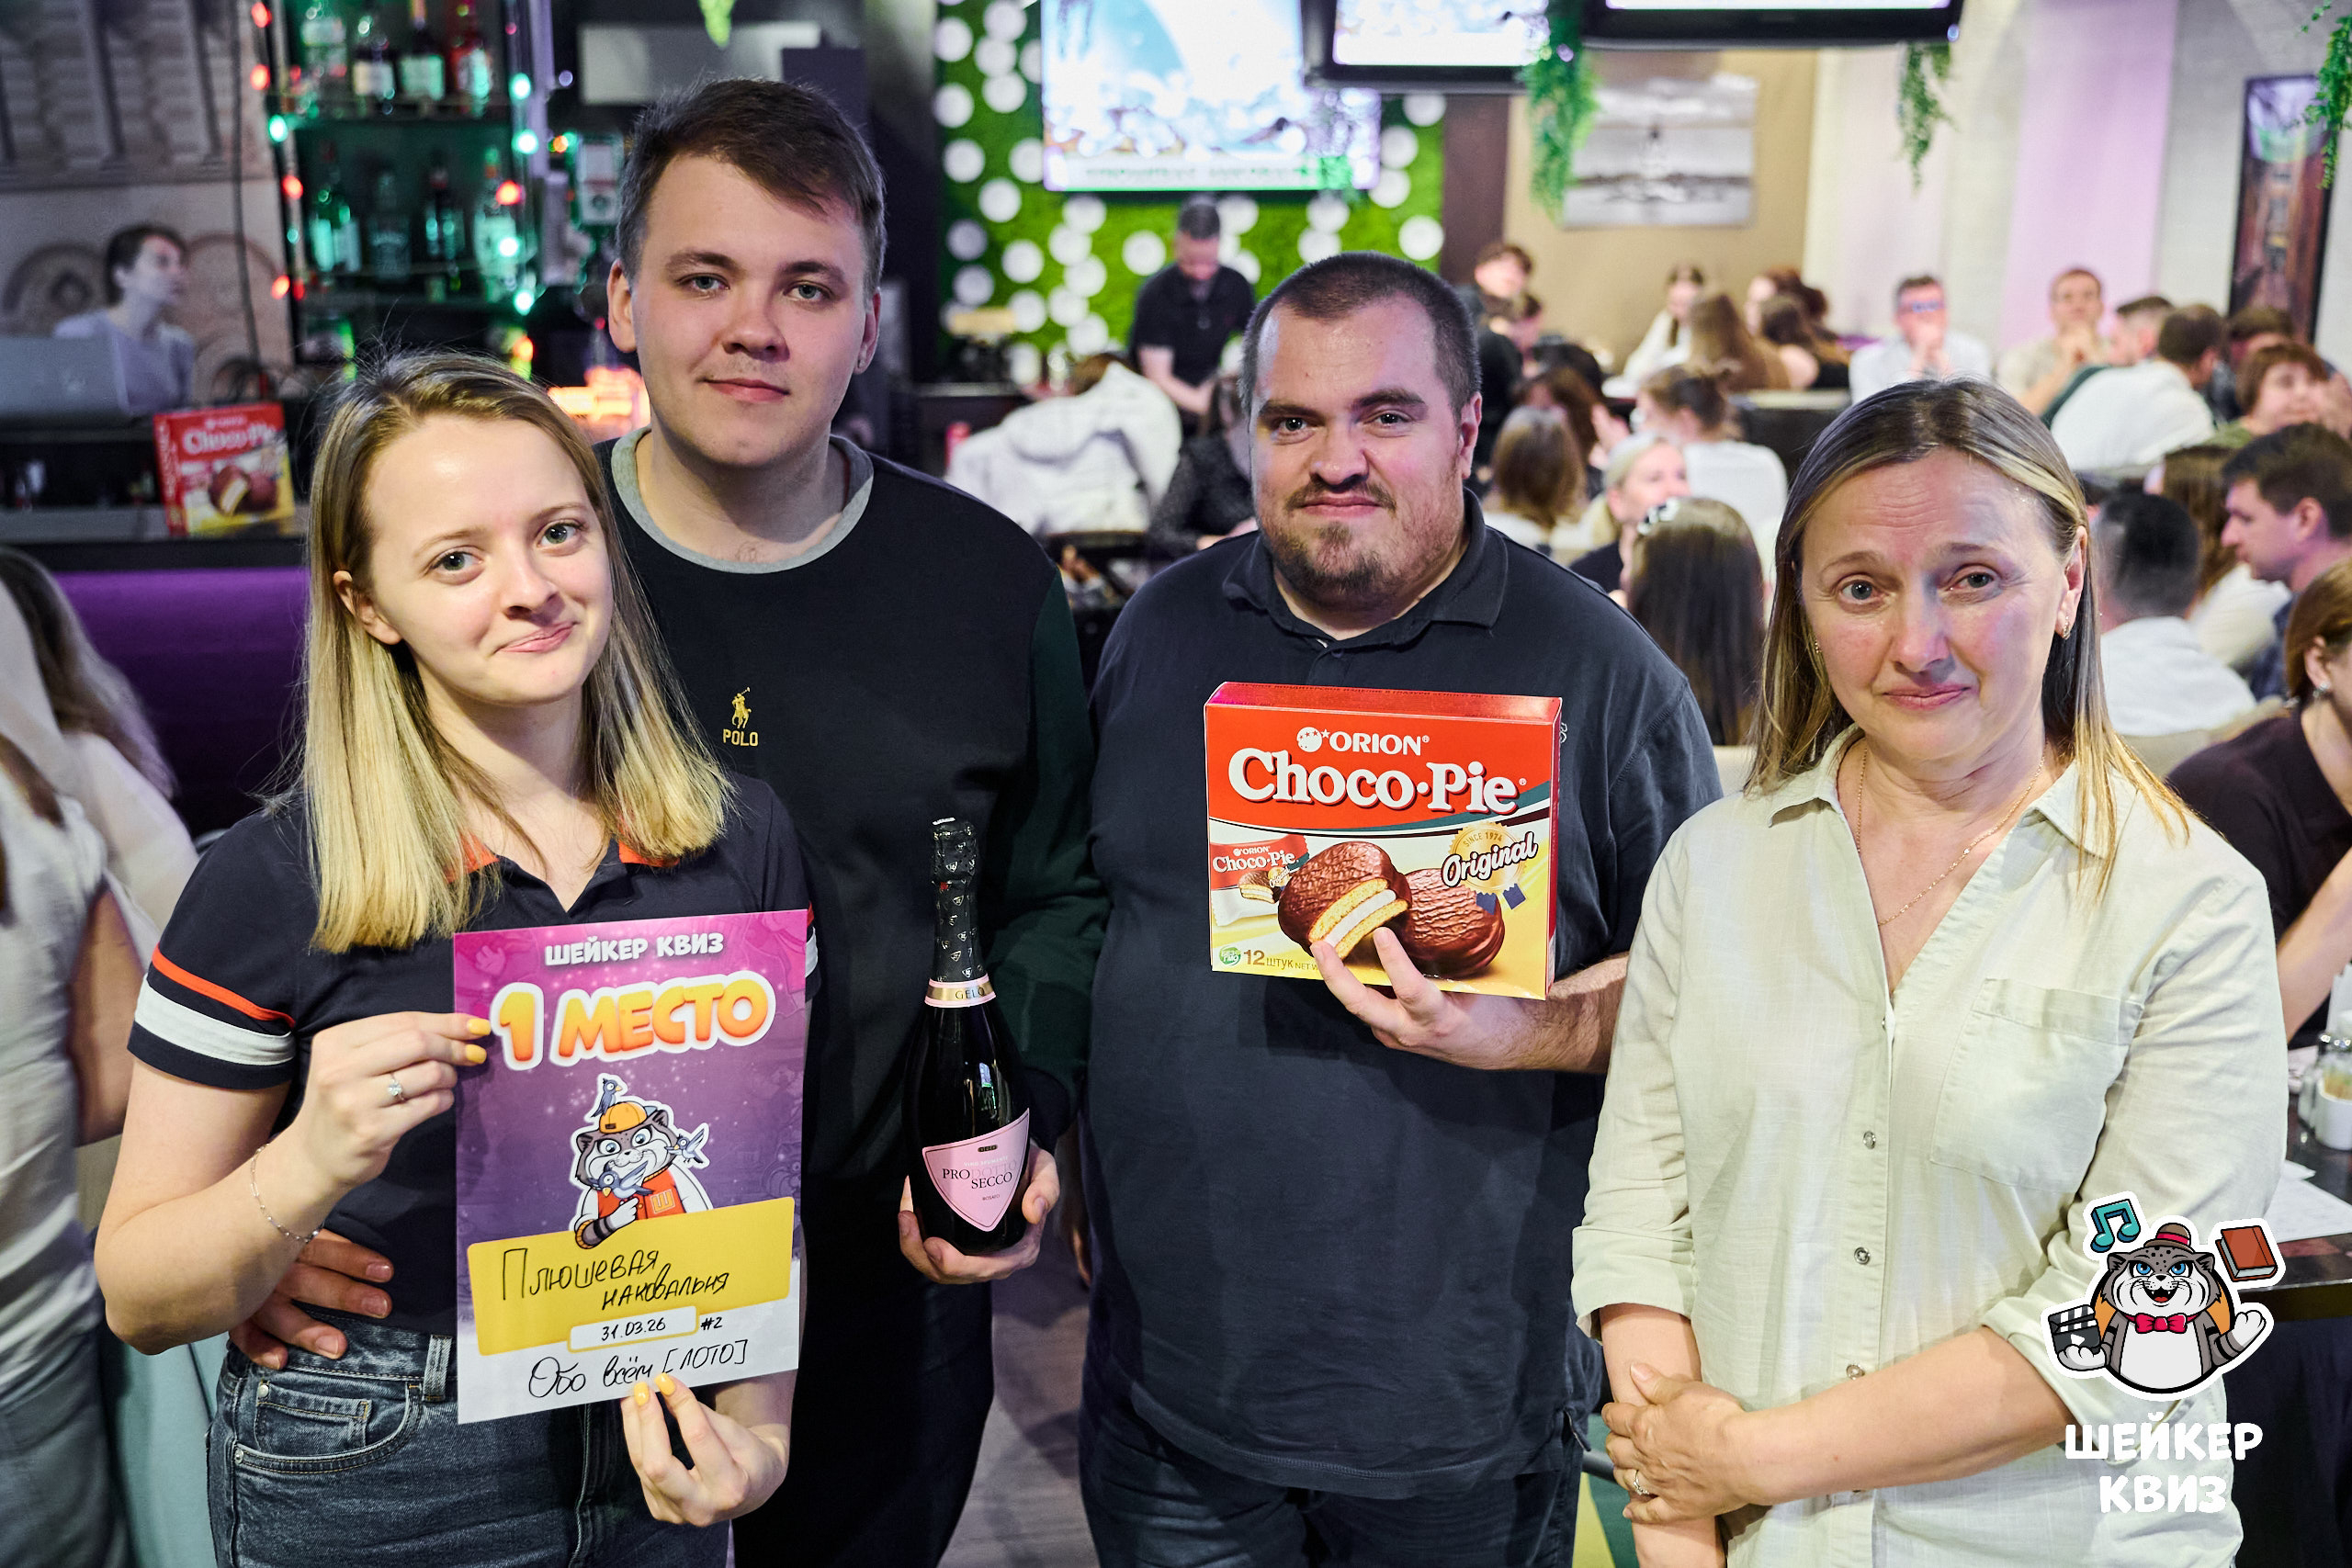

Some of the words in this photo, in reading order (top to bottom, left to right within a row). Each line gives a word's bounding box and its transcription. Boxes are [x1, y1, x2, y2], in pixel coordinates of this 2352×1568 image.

[722, 728, 759, 747] POLO
[1329, 730, 1421, 756] ORION
[1242, 846, 1269, 855] ORION
[1463, 832, 1483, 847] SINCE
[1485, 831, 1503, 842] 1974
[1441, 830, 1539, 888] Original
[545, 936, 649, 966] ШЕЙКЕР
[656, 932, 725, 958] КВИЗ
[1243, 949, 1265, 965] 12
[1266, 957, 1294, 971] ШТУК
[1295, 962, 1311, 970] NET
[955, 987, 985, 1000] GELO
[493, 986, 541, 1066] 1
[555, 976, 772, 1062] МЕСТО
[971, 1171, 1012, 1190] SECCO
[601, 1316, 667, 1341] 31.03.26
[527, 1356, 587, 1398] Обо
